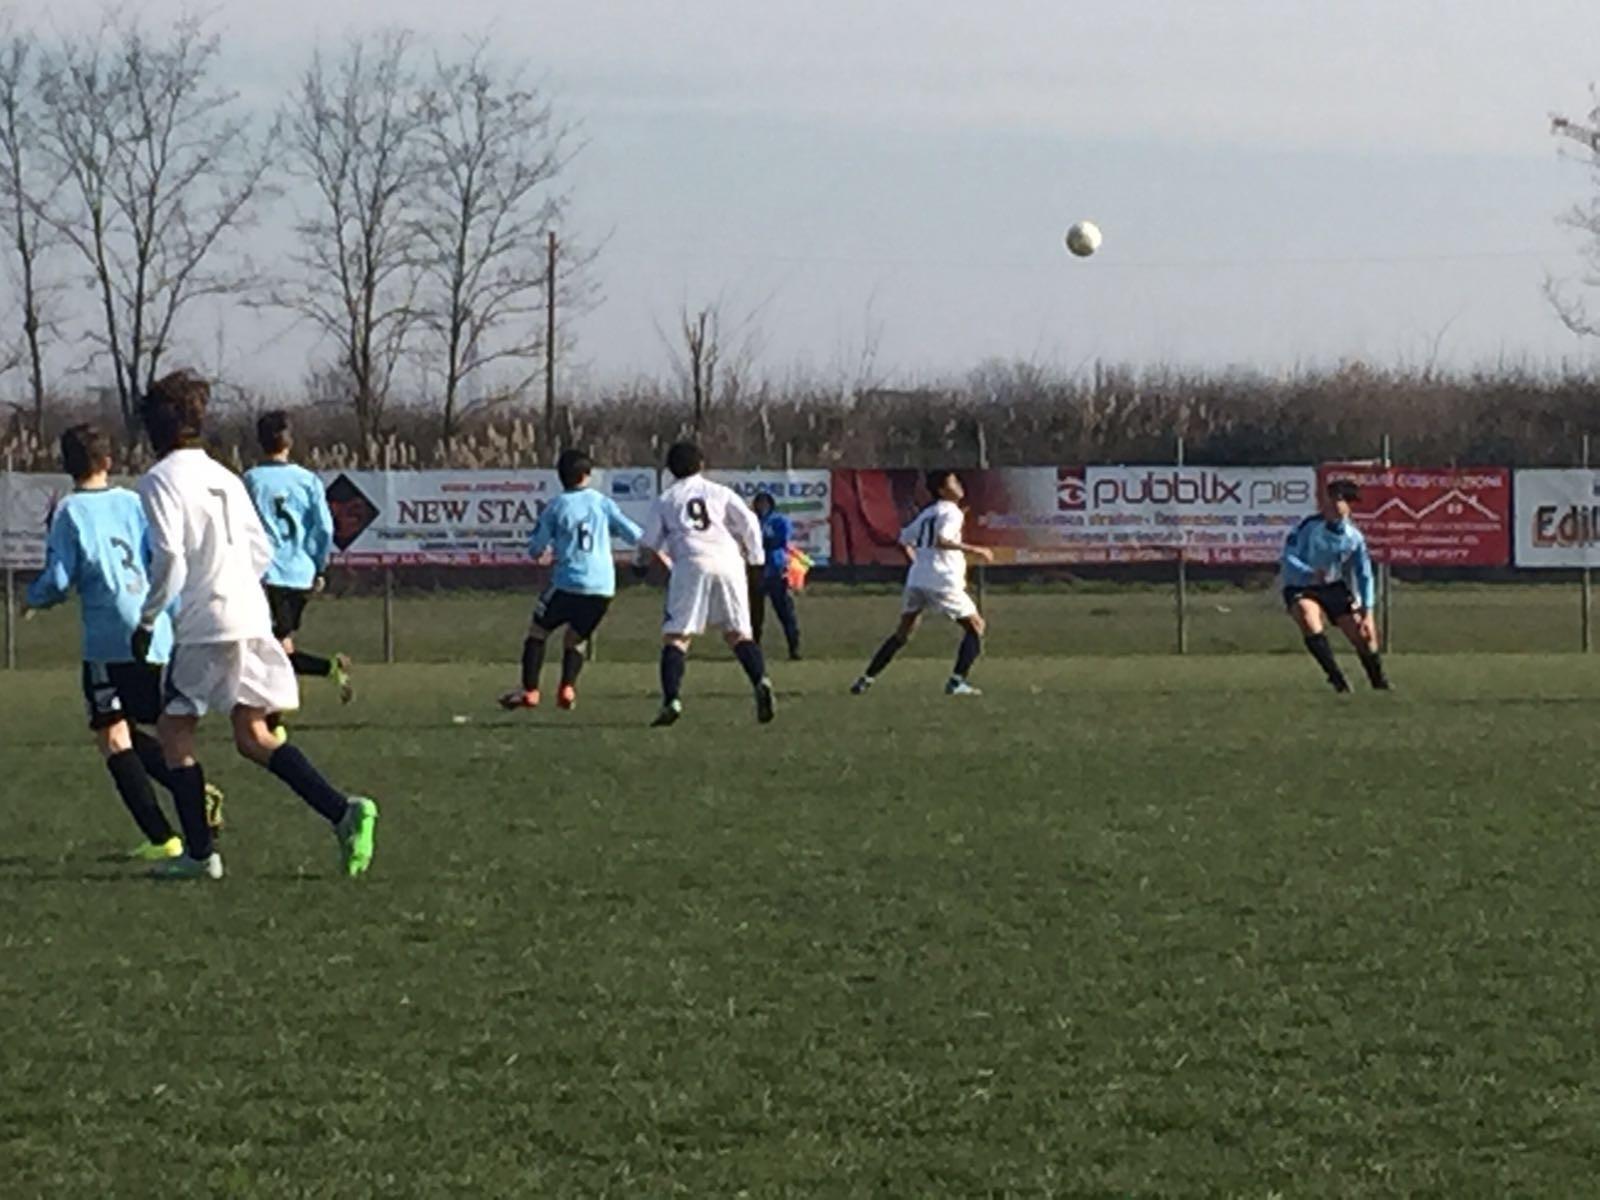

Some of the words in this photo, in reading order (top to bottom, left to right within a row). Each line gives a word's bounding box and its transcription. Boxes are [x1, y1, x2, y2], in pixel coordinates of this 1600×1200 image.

[208, 487, 234, 545] 7
[272, 496, 298, 542] 5
[397, 500, 471, 525] NEW
[686, 497, 712, 531] 9
[576, 522, 593, 553] 6
[915, 516, 937, 548] 11
[110, 537, 145, 595] 3
